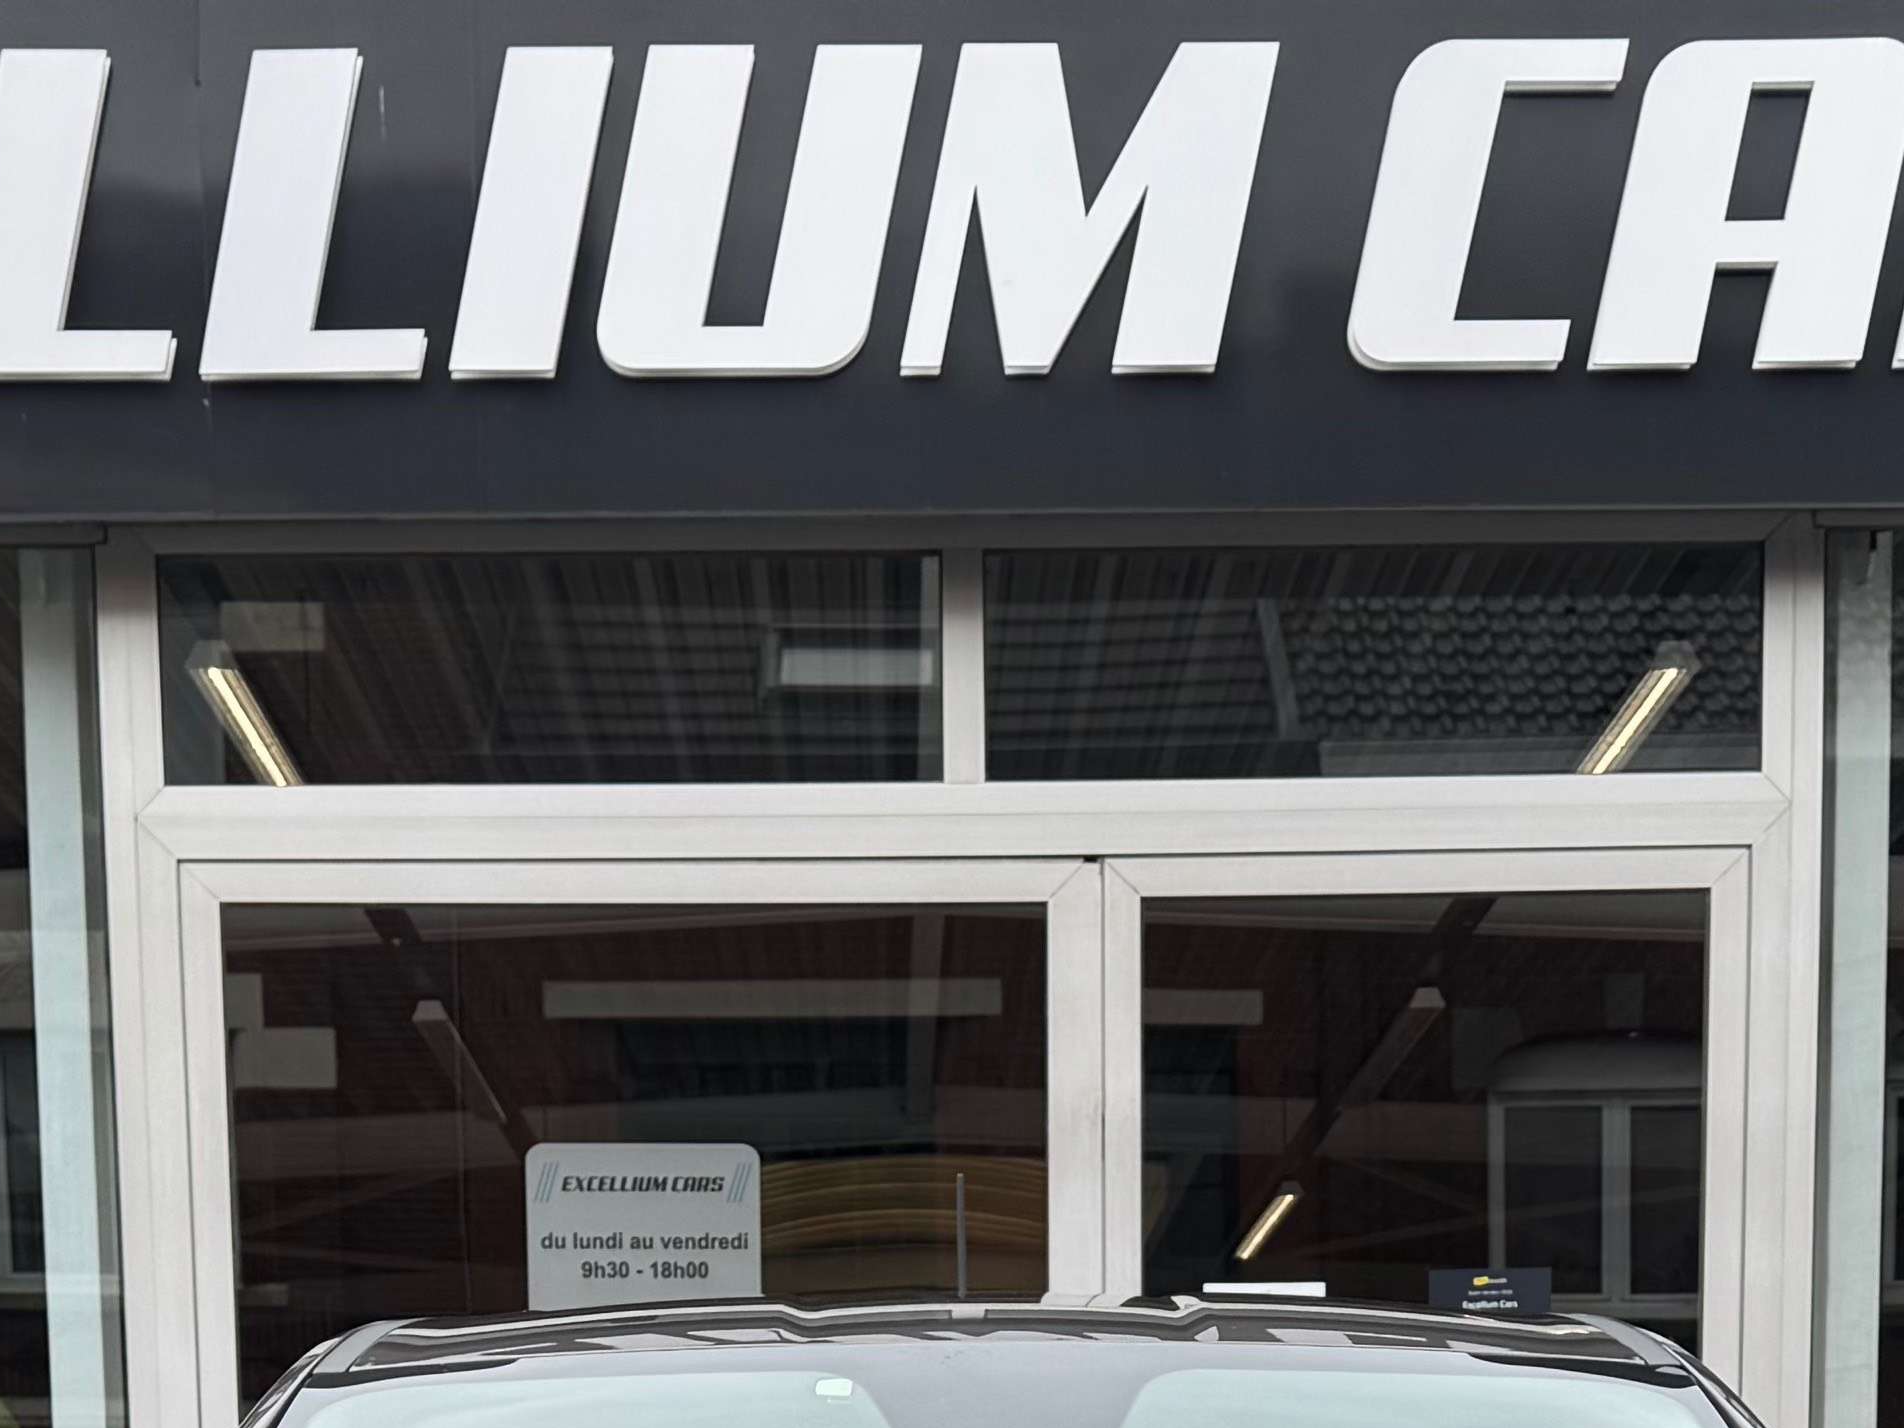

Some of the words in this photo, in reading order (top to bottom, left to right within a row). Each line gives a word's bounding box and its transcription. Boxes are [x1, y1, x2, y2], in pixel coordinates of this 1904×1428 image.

[561, 1175, 670, 1192] EXCELLIUM
[672, 1175, 725, 1192] CARS
[541, 1232, 566, 1250] du
[573, 1231, 623, 1250] lundi
[630, 1236, 653, 1250] au
[660, 1231, 748, 1250] vendredi
[581, 1261, 629, 1278] 9h30
[651, 1261, 709, 1278] 18h00
